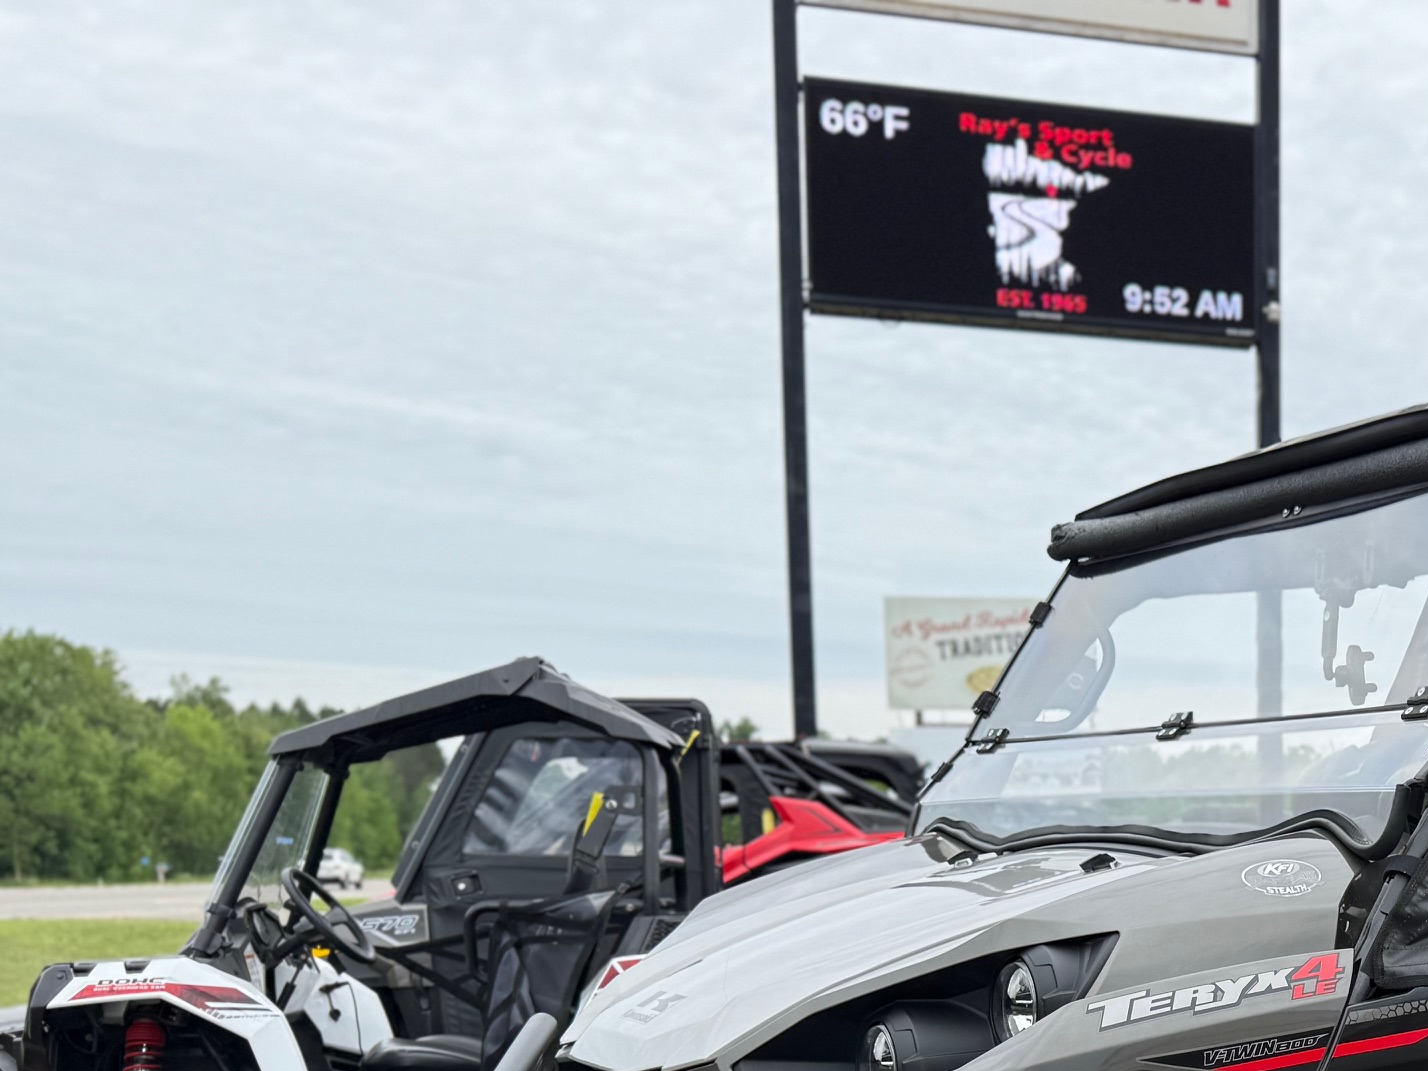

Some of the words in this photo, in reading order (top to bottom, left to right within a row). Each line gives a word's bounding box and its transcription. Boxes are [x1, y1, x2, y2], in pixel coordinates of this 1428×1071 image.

[819, 98, 910, 139] 66°F
[958, 112, 1031, 140] Ray's
[1038, 121, 1113, 147] Sport
[1034, 141, 1054, 160] &
[1060, 144, 1132, 168] Cycle
[1123, 283, 1189, 316] 9:52
[1194, 290, 1243, 321] AM
[891, 619, 913, 639] A
[976, 608, 1031, 633] Rapid
[935, 631, 1025, 661] TRADITIO
[1264, 863, 1294, 875] KFI
[1266, 884, 1307, 894] STEALTH
[1291, 977, 1342, 1000] LE
